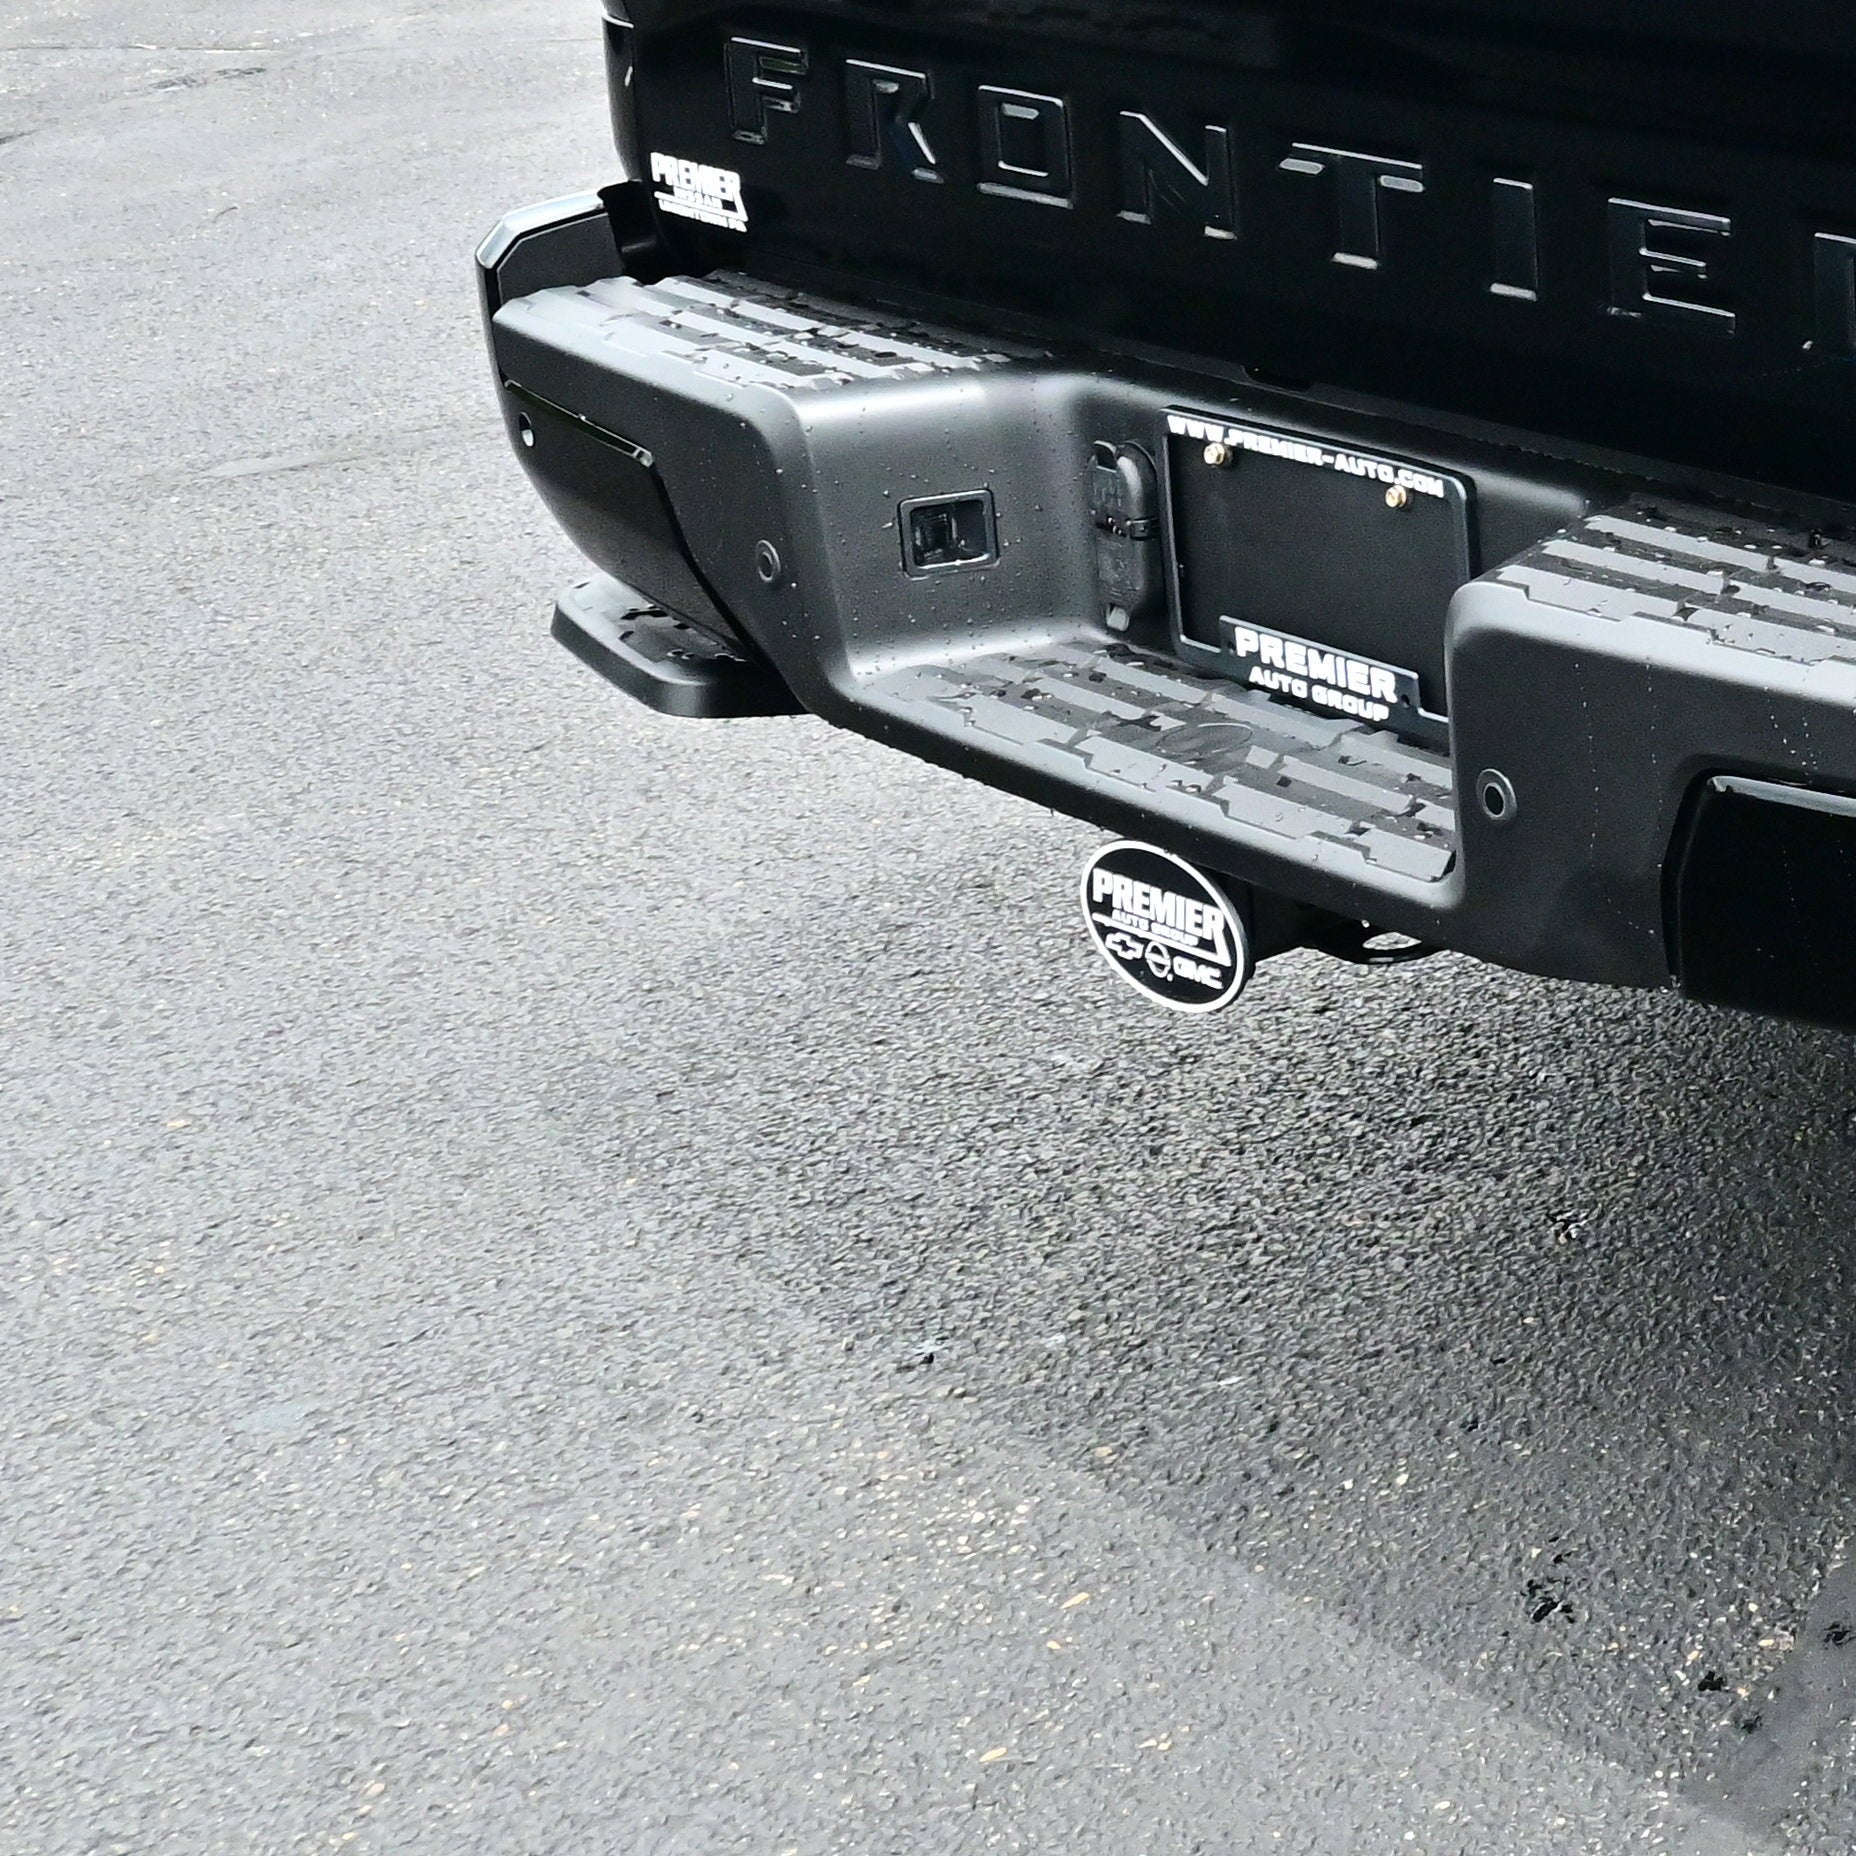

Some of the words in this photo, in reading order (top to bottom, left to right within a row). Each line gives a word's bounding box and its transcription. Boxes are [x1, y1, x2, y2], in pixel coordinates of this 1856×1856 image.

[649, 151, 744, 204] PREMIER
[1166, 414, 1445, 499] WWW.PREMIER-AUTO.COM
[1234, 625, 1399, 705] PREMIER
[1248, 665, 1309, 700] AUTO
[1311, 685, 1390, 722] GROUP
[1092, 867, 1228, 944] PREMIER
[1111, 908, 1150, 932] AUTO
[1172, 955, 1225, 990] GMC
